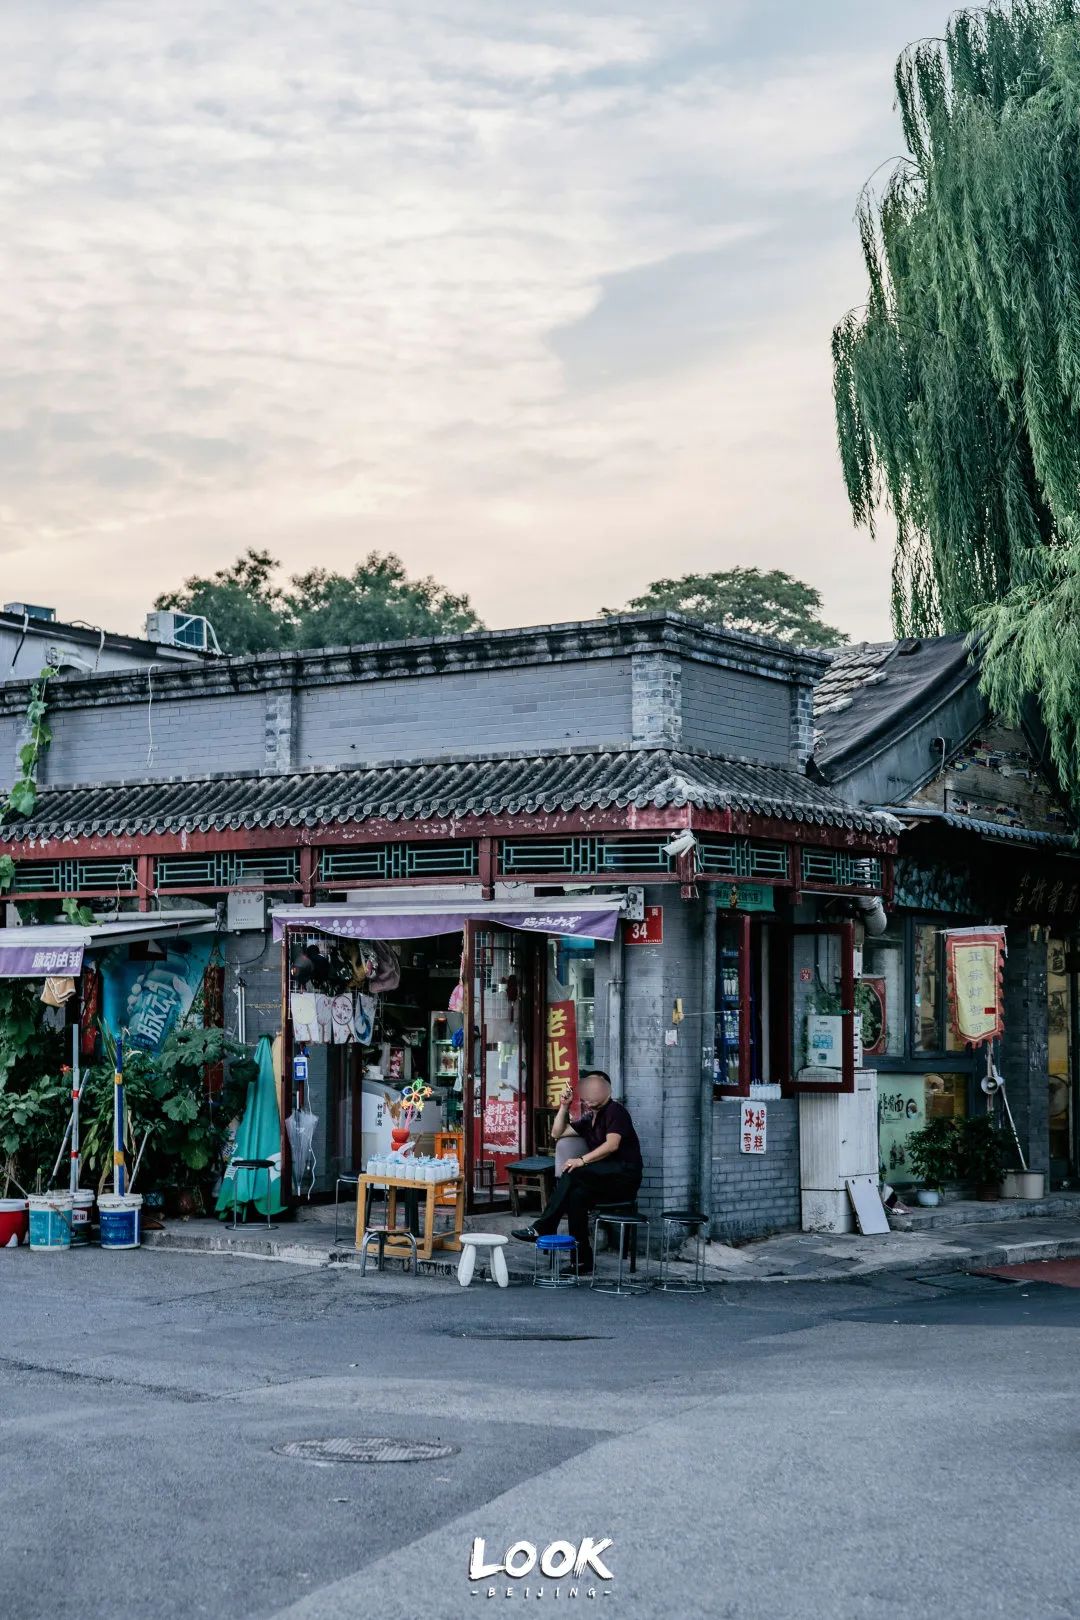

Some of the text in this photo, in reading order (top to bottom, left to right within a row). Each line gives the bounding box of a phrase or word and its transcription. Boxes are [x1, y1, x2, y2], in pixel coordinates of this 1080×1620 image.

[632, 922, 648, 939] 34
[546, 1008, 571, 1107] 老北京
[486, 1103, 515, 1115] 老北京
